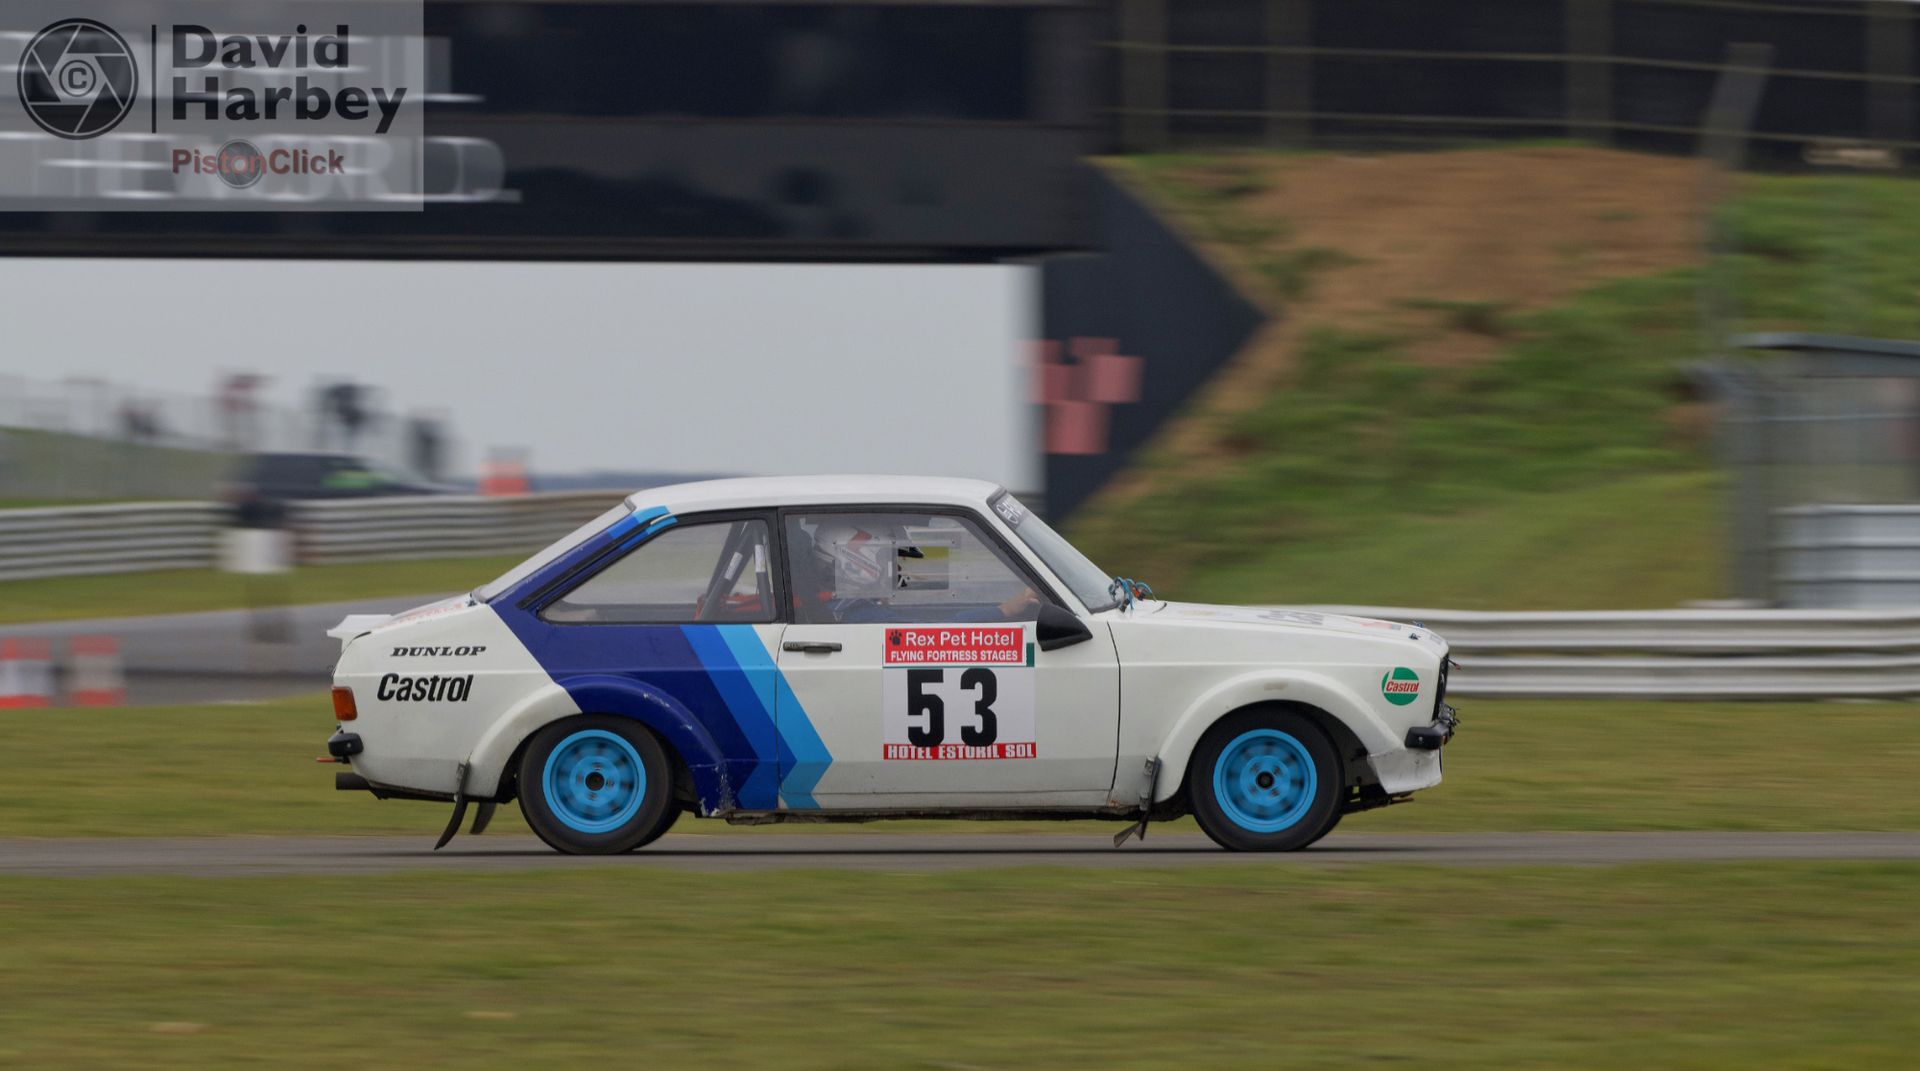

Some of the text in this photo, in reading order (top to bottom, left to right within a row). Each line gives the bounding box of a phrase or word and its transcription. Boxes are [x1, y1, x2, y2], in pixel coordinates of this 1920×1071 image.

[905, 630, 1015, 646] Rex Pet Hotel
[390, 646, 487, 657] DUNLOP
[891, 650, 1018, 661] FLYING FORTRESS STAGES
[377, 673, 474, 702] Castrol
[1386, 680, 1419, 692] Castrol
[907, 667, 998, 747] 53
[887, 743, 1035, 759] HOTEL ESTORIL SOL
